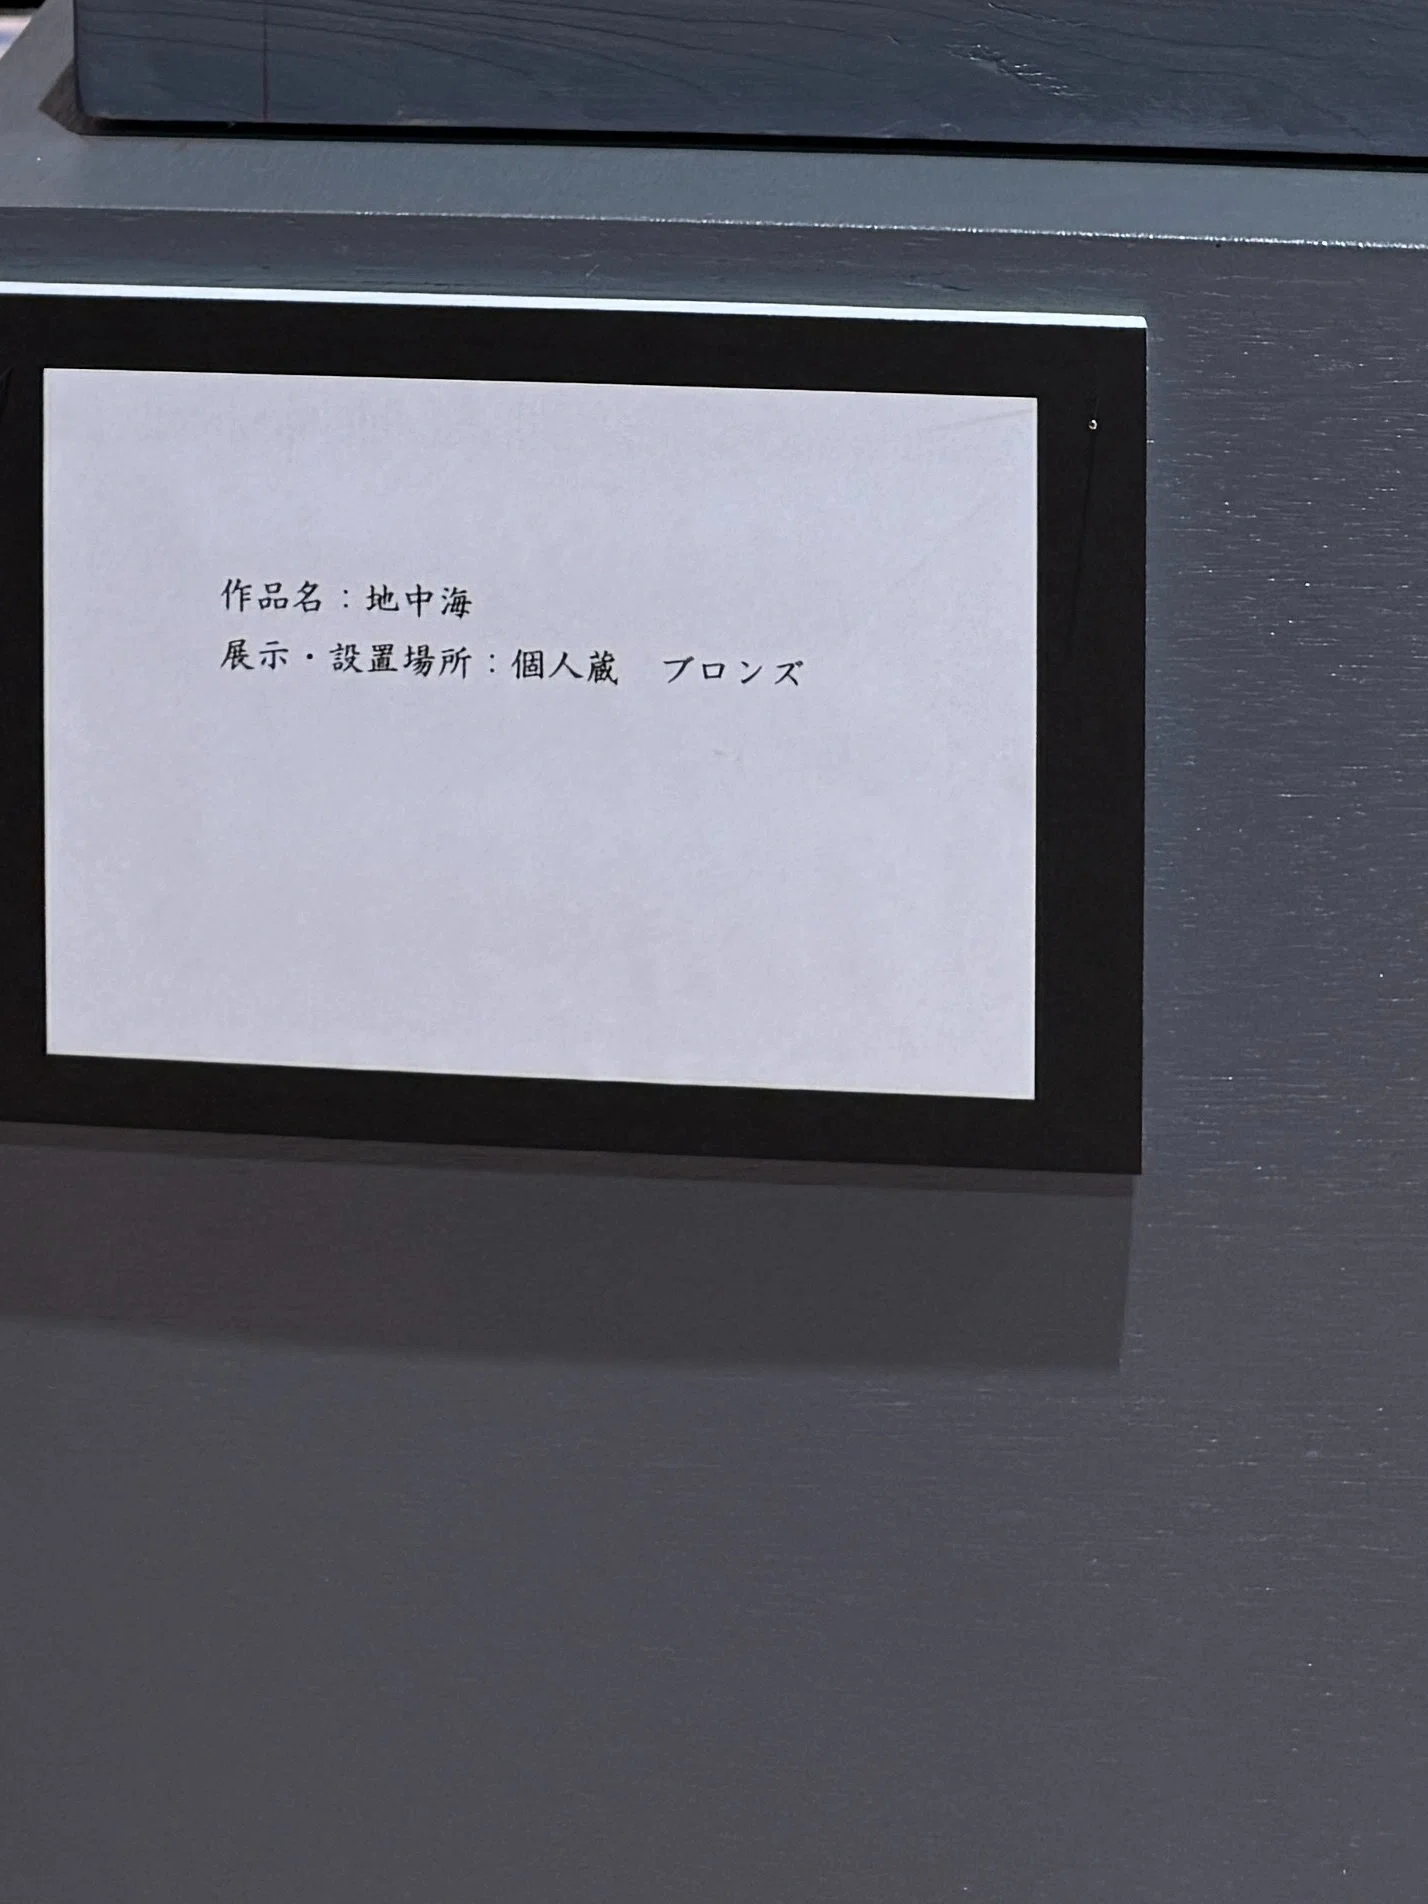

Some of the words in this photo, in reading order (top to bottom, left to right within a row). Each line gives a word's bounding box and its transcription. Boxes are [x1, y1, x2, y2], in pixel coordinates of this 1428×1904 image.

[220, 577, 473, 620] 作品名：地中海
[220, 638, 619, 686] 展示・設置場所：個人蔵
[663, 655, 804, 687] ブロンズ
